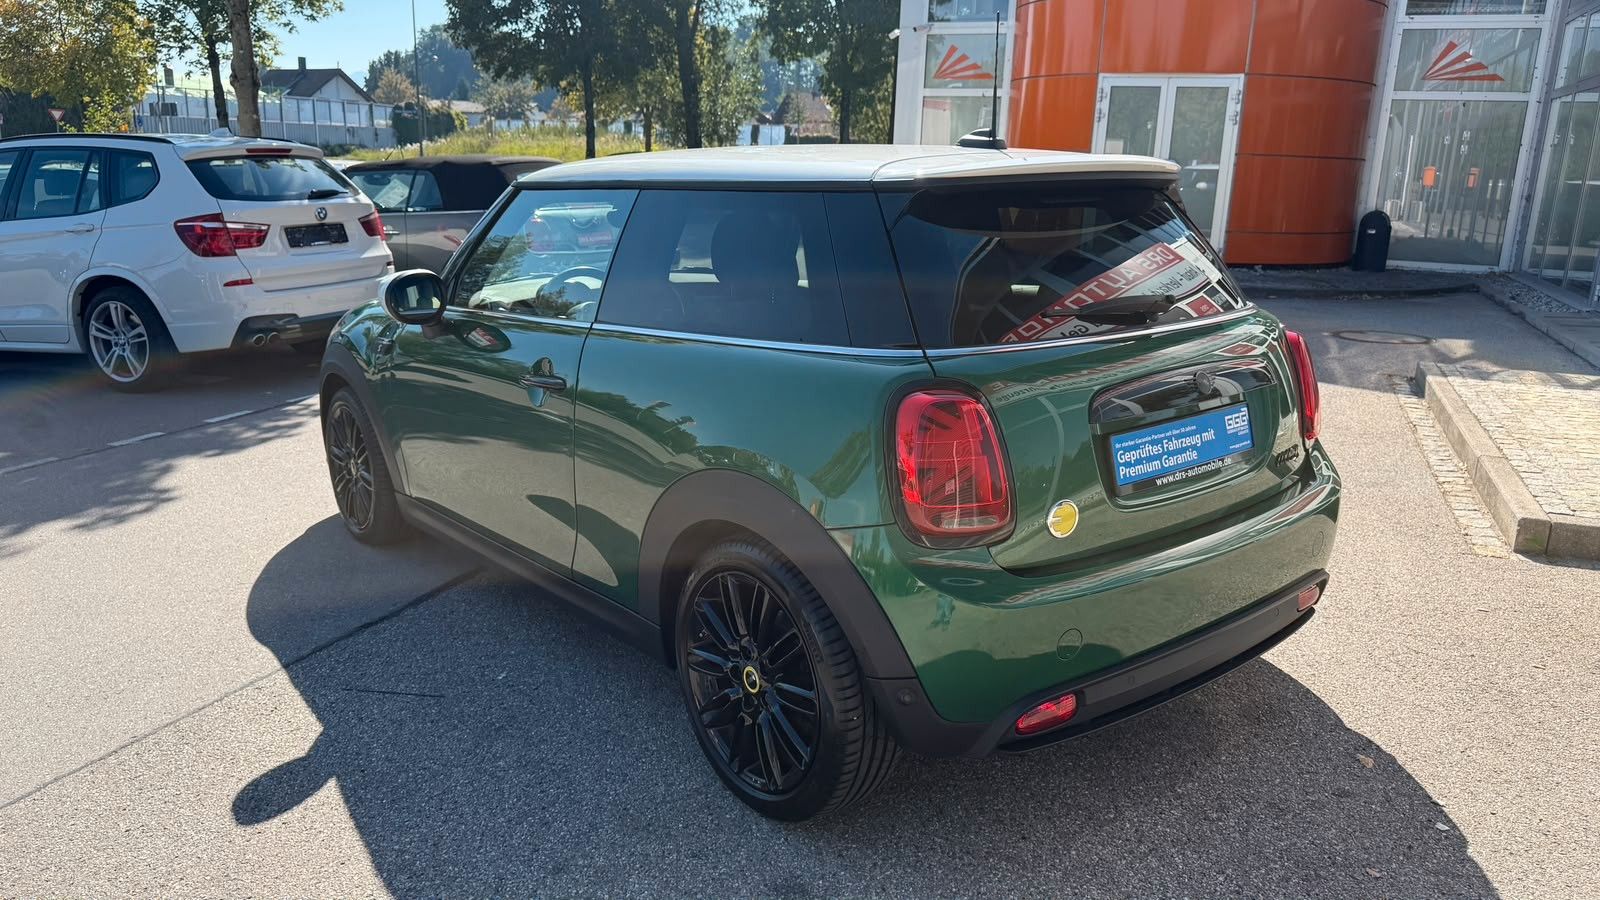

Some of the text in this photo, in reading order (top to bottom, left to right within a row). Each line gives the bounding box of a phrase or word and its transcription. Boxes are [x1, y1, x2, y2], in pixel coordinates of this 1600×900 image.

[1225, 408, 1249, 429] GGG
[1117, 443, 1162, 464] Geprüftes
[1163, 433, 1201, 452] Fahrzeug
[1202, 429, 1215, 442] mit
[1119, 449, 1198, 479] Premium Garantie
[1155, 457, 1232, 486] www.drs-automobile.de
